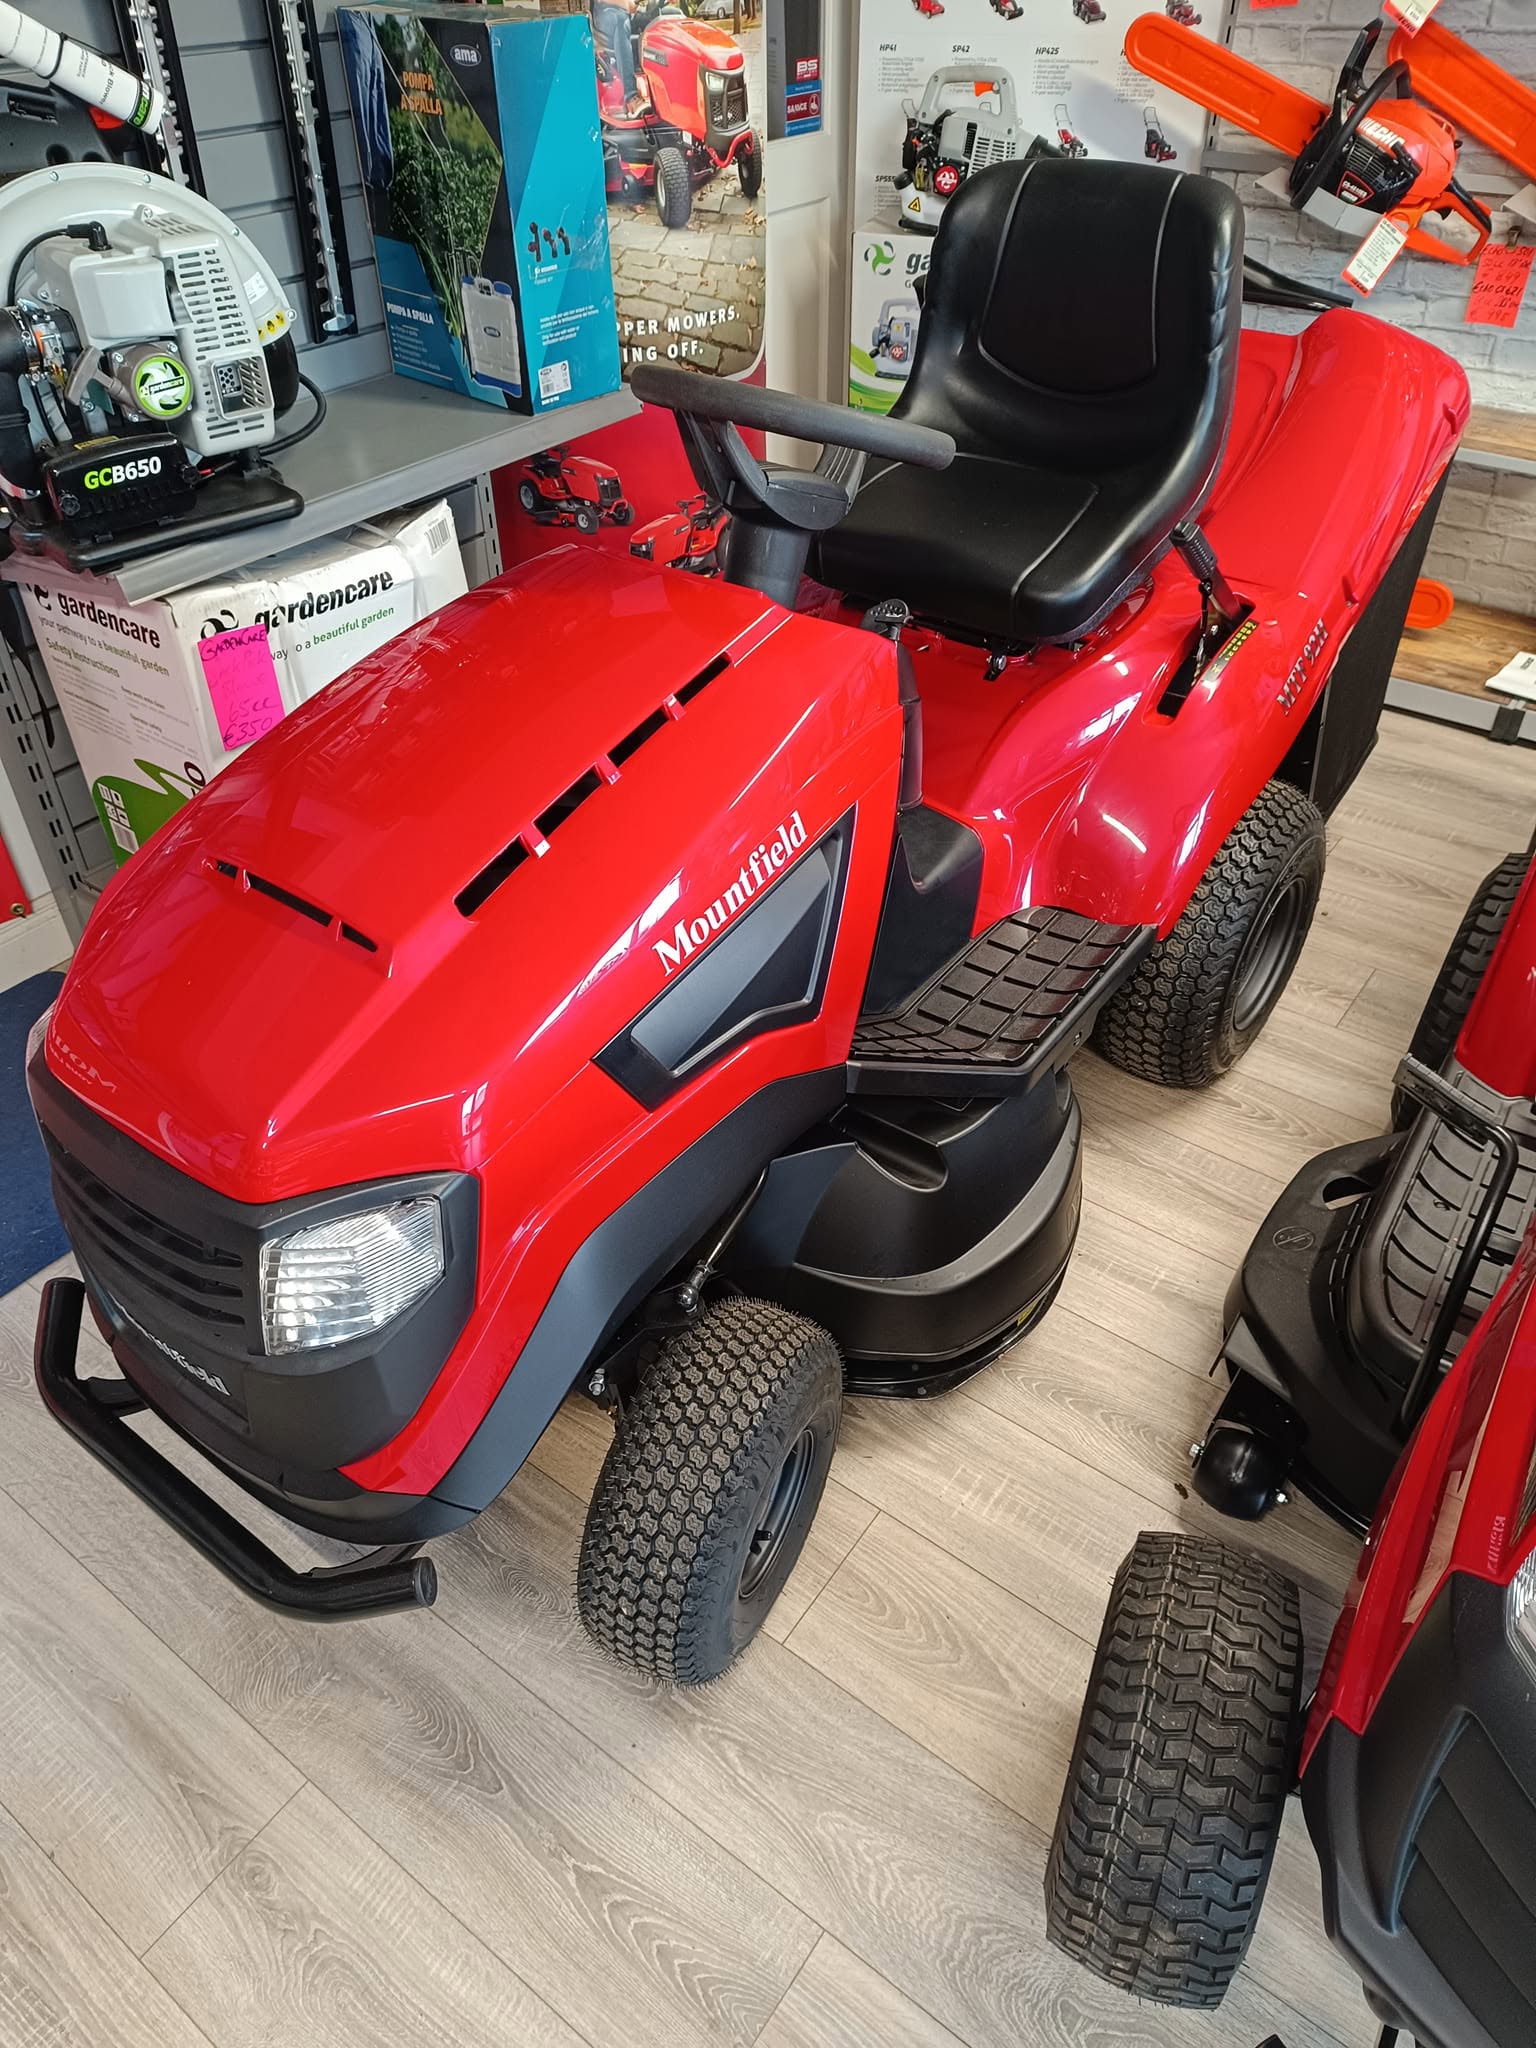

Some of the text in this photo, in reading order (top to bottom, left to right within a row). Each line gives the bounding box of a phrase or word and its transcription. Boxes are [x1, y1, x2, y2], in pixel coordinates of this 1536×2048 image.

[454, 48, 478, 62] ama
[952, 44, 970, 53] SP42
[1035, 47, 1060, 55] HP425
[402, 71, 435, 91] POMPA
[797, 59, 818, 73] BS
[401, 94, 442, 115] A SPALLA
[668, 305, 740, 333] MOWERS.
[667, 340, 704, 359] OFF.
[84, 456, 162, 489] GCB650
[255, 571, 394, 634] gardencare
[58, 593, 161, 648] gardencare
[305, 640, 311, 649] a
[313, 618, 359, 645] beautiful
[361, 607, 394, 629] garden
[39, 616, 55, 628] your
[57, 622, 88, 645] pathway
[88, 635, 97, 645] to
[103, 640, 140, 664] beautiful
[140, 657, 169, 677] garden
[46, 637, 120, 678] Safety Instructions
[1276, 655, 1308, 717] MTF
[652, 809, 808, 977] Mountfield
